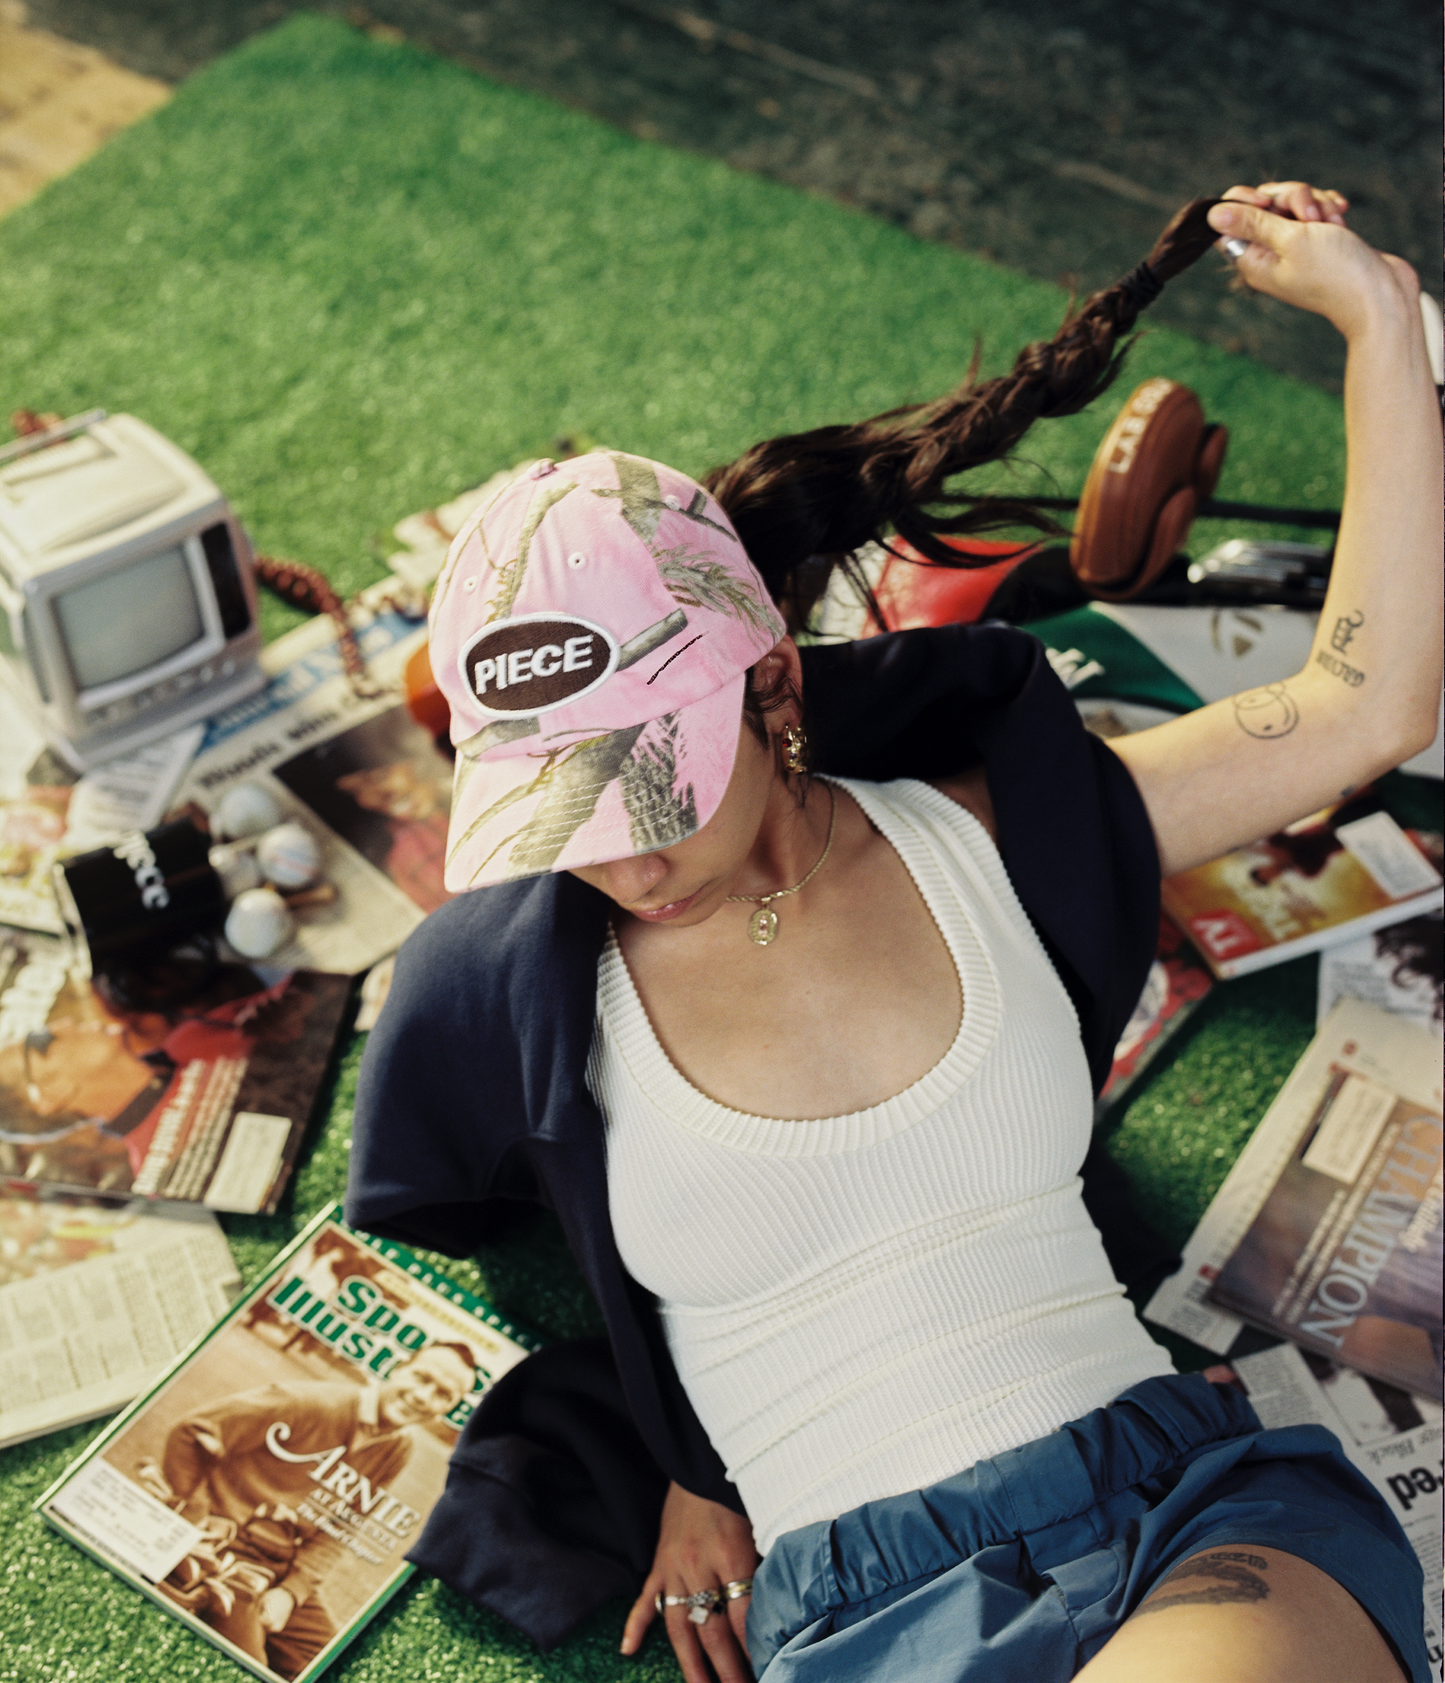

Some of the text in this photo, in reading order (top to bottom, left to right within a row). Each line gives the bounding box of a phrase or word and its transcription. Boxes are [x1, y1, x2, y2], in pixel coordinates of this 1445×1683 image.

[474, 634, 594, 695] PIECE
[1194, 919, 1241, 956] TV
[1300, 1114, 1442, 1349] CHAMPION
[265, 1421, 421, 1539] ARNIE
